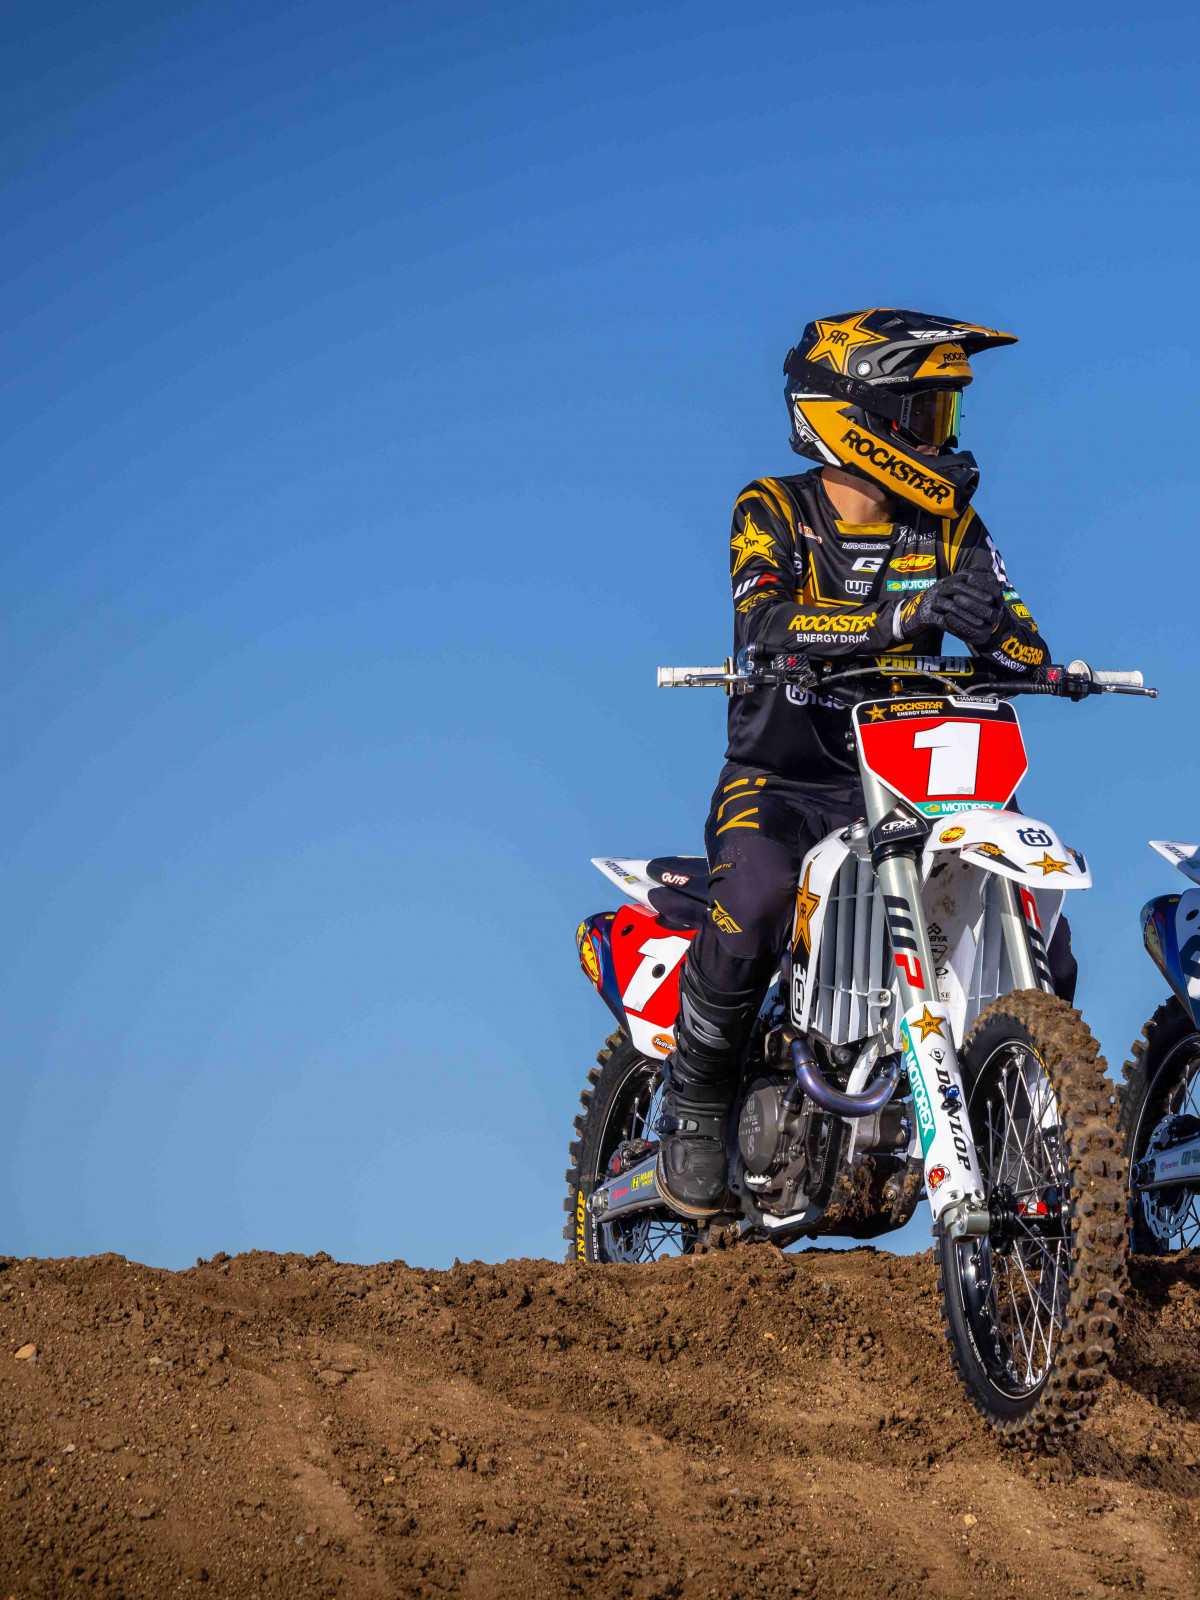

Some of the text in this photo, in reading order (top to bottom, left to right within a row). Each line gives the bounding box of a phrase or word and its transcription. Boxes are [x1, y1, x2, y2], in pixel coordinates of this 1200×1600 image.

[840, 428, 950, 504] ROCKSTAR
[902, 579, 936, 590] MOTORE
[788, 612, 877, 632] ROCKSTAR
[796, 633, 838, 643] ENERGY
[890, 702, 943, 712] ROCKSTAR
[957, 696, 994, 704] HAMPSHIRE
[913, 721, 981, 797] 1
[941, 803, 996, 813] MOTOREX
[662, 872, 689, 885] GUTS
[622, 935, 691, 1013] 1
[653, 1036, 677, 1051] Twin Air
[906, 1051, 935, 1137] MOTOREX
[936, 1068, 972, 1171] DNLOP
